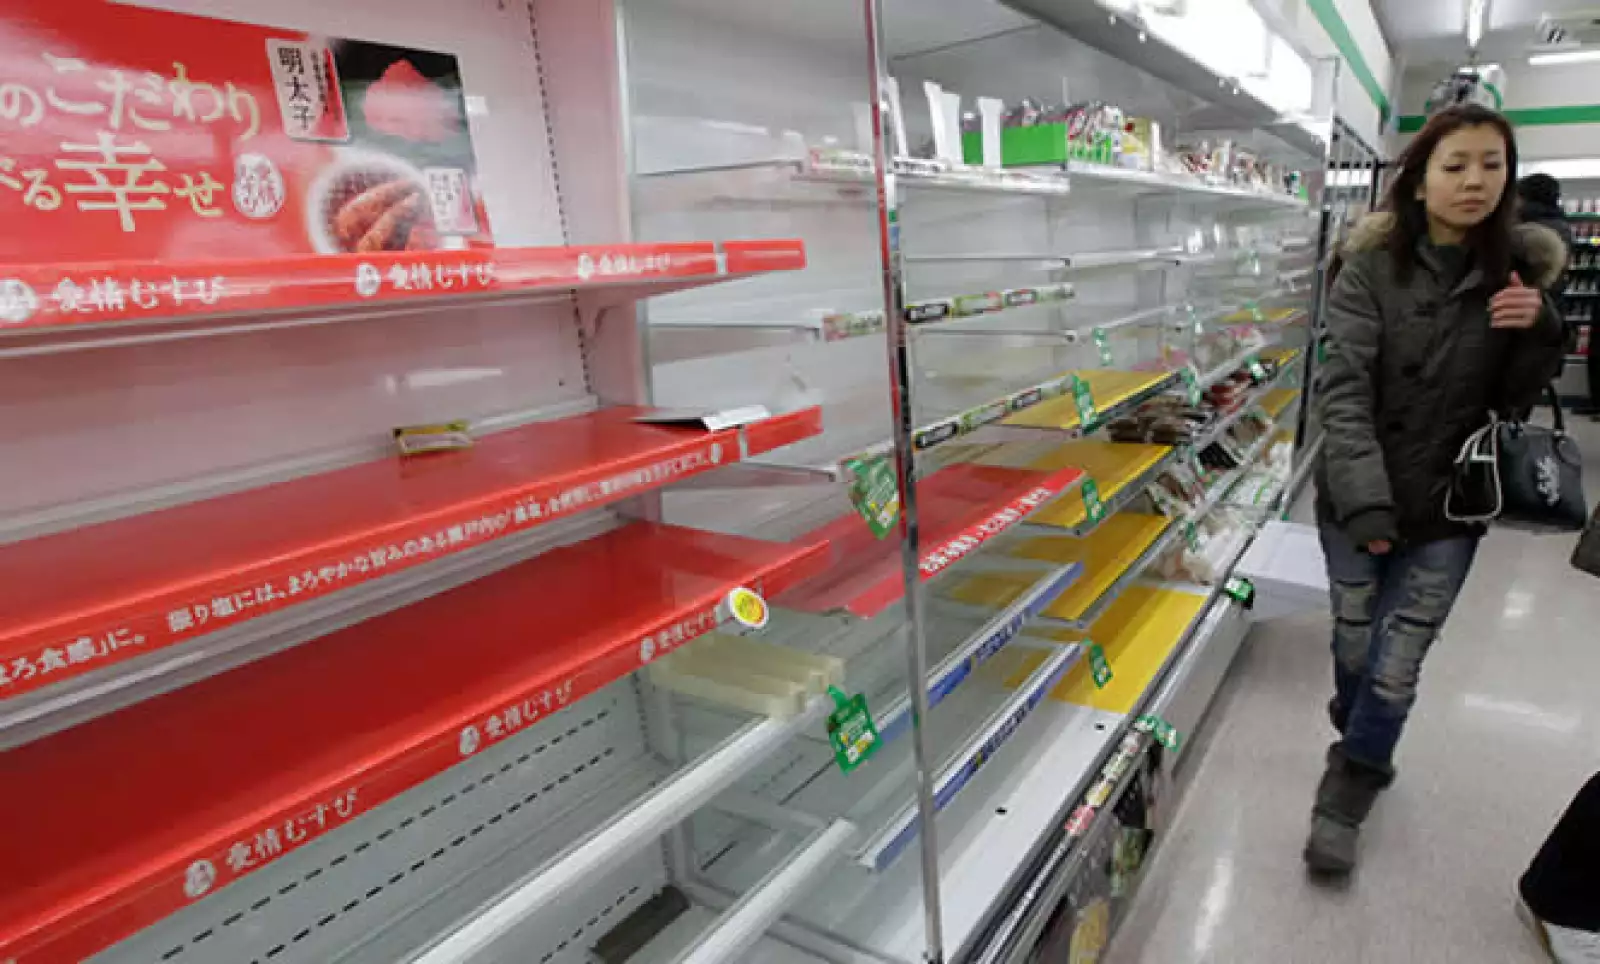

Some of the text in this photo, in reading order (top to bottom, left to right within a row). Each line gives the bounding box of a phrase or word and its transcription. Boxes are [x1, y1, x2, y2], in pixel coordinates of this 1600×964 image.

[0, 52, 261, 141] のこだわり
[226, 787, 358, 873] 愛情むすび
